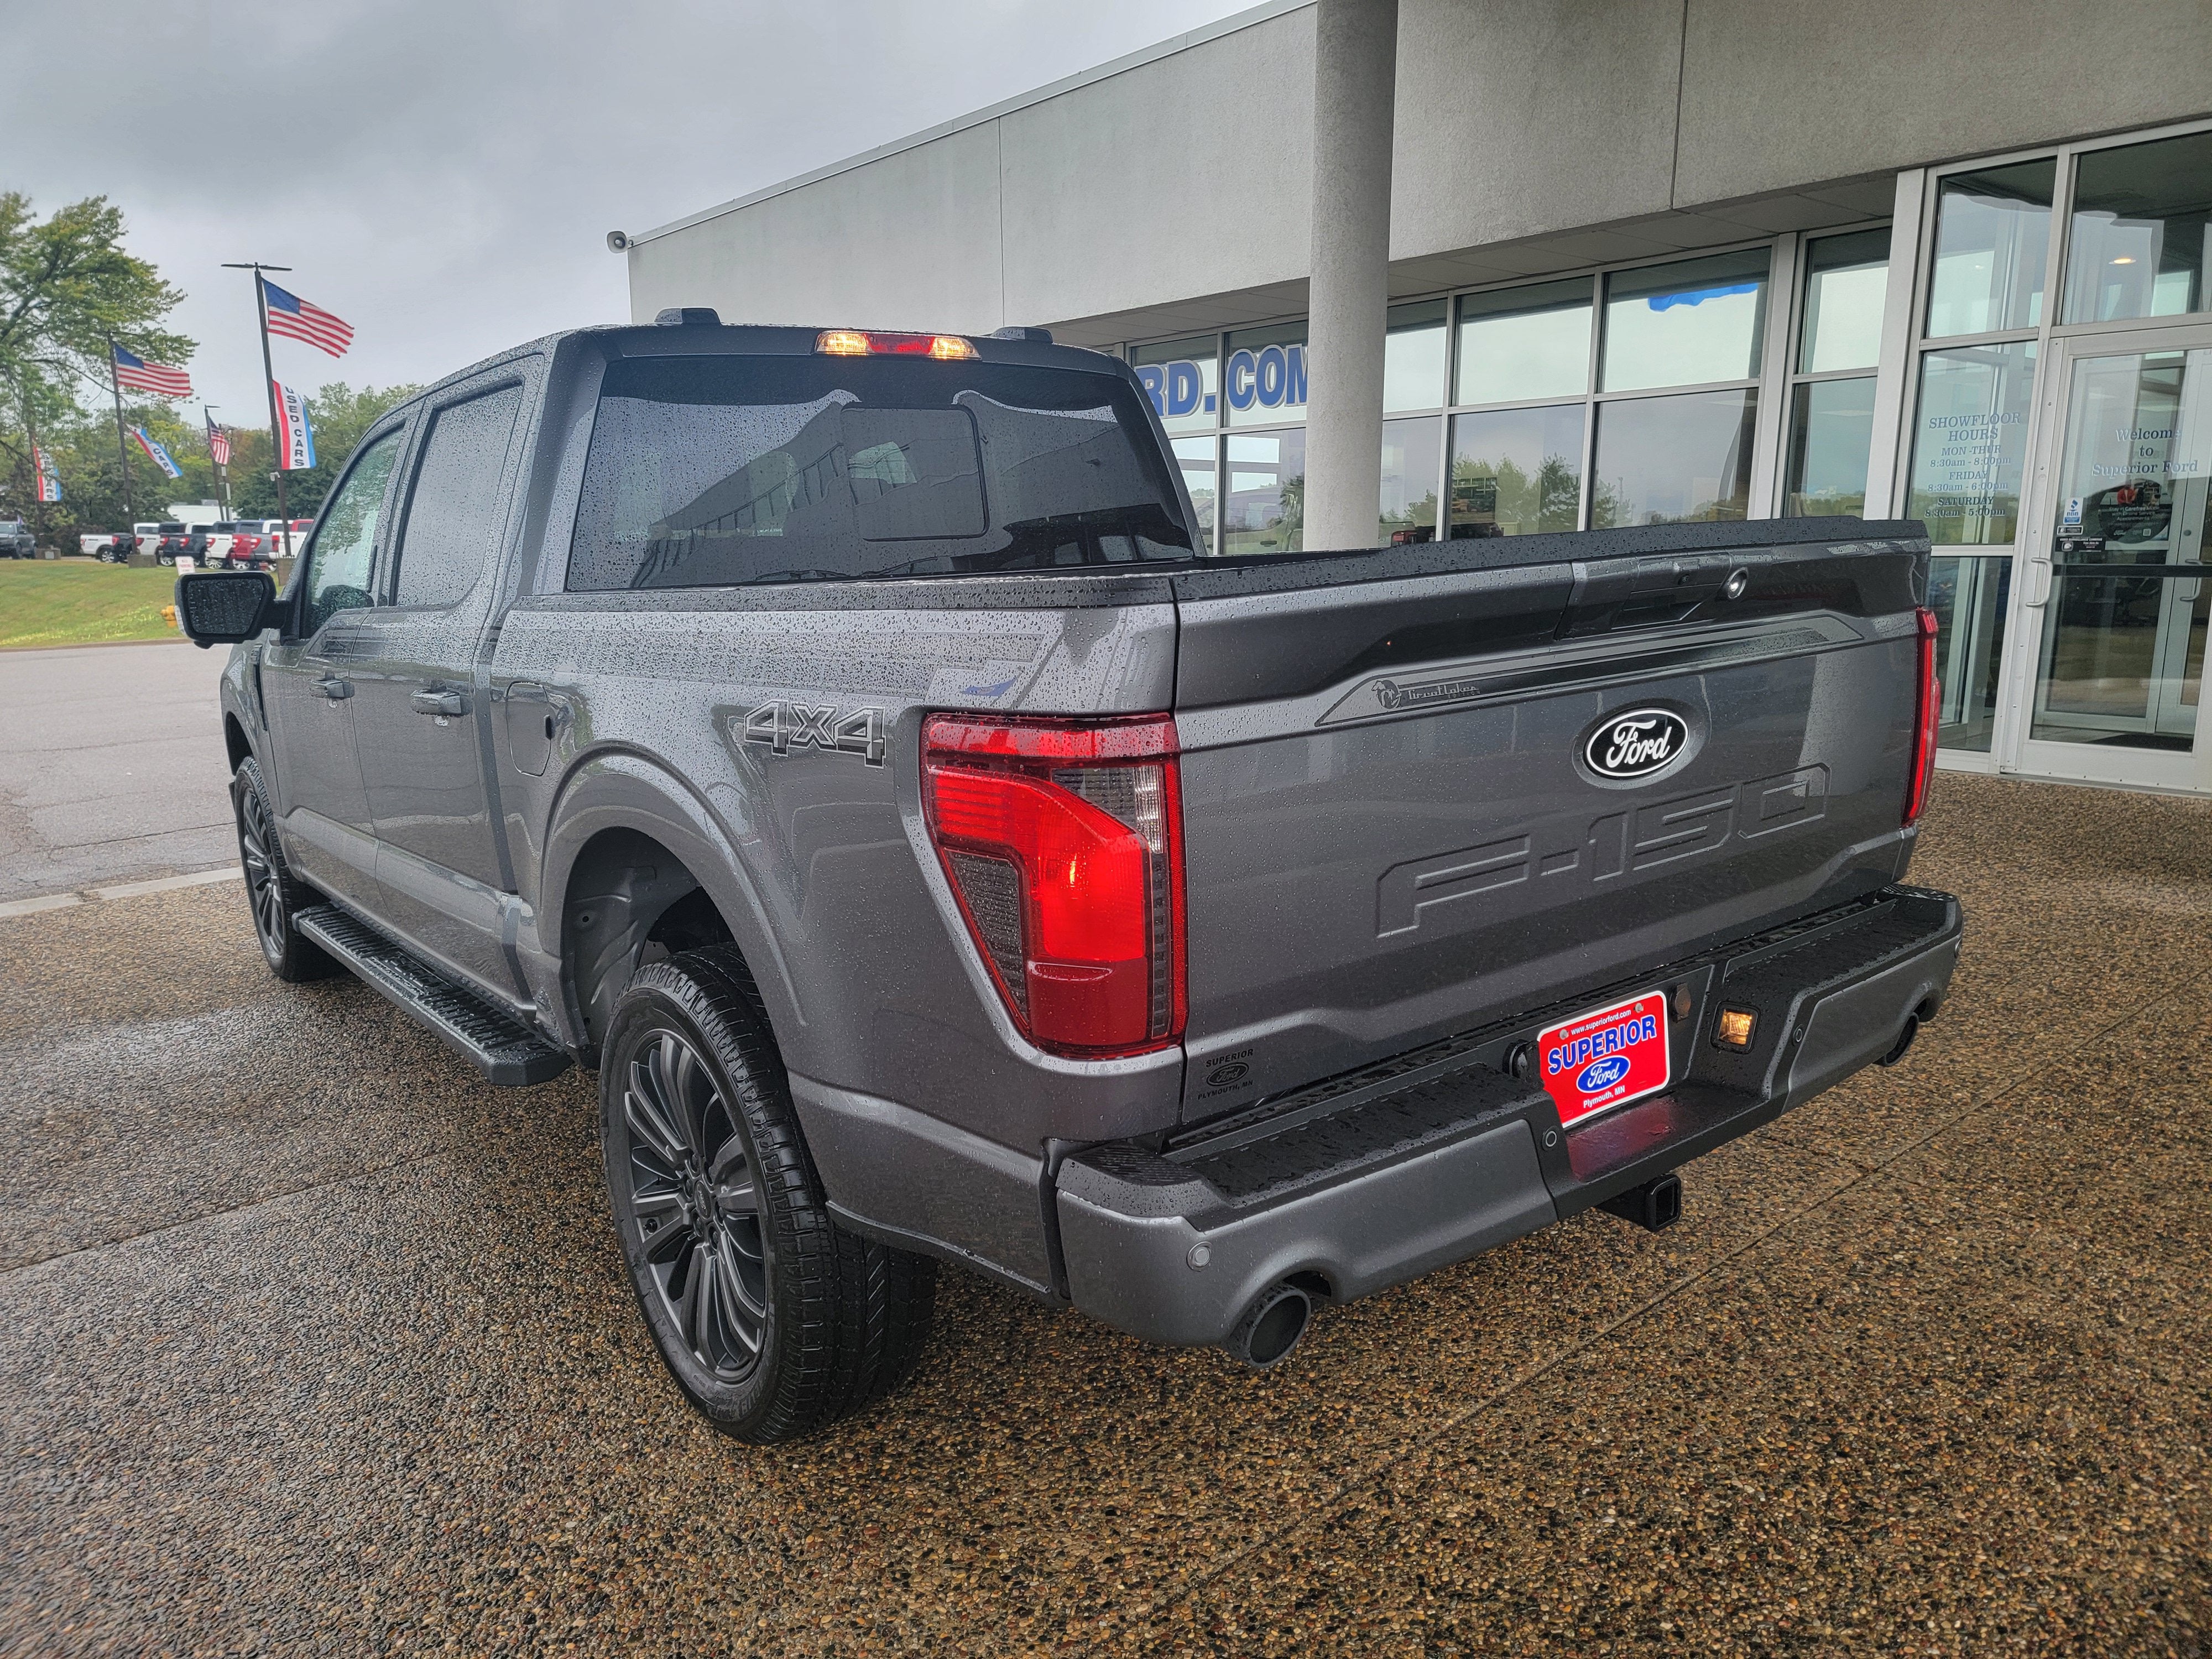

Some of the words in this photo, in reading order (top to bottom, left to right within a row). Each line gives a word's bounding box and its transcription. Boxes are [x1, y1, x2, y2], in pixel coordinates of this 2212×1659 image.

[285, 387, 299, 422] USED
[294, 429, 304, 466] CARS
[1929, 413, 2021, 429] SHOWFLOOR
[1948, 428, 1998, 441] HOURS
[2116, 428, 2182, 441] Welcome
[2140, 445, 2153, 457] to
[153, 448, 173, 475] CARS
[1930, 459, 1965, 467] 8:30am
[1974, 457, 2011, 467] 8:00pm
[2093, 462, 2158, 478] Superior
[2162, 460, 2198, 474] Ford
[1949, 471, 1987, 480] FRIDAY
[1928, 483, 1963, 492] 8:30am
[1971, 482, 2008, 492] 6:00pm
[1937, 496, 1994, 507] SATURDAY
[1924, 508, 1960, 518] 8:30am
[1968, 507, 2005, 518] 5:00pm
[1606, 719, 1672, 768] Ford
[1376, 762, 1832, 939] F-150
[1571, 1009, 1631, 1036] www.superiorford.com
[1548, 1015, 1656, 1075] SUPERIOR
[1206, 1048, 1254, 1068] SUPERIOR
[1216, 1067, 1240, 1082] Ford
[1587, 1061, 1620, 1088] Ford
[1198, 1084, 1240, 1100] PLYMOUTH,
[1583, 1091, 1614, 1108] Plymouth,
[1615, 1085, 1625, 1095] MN
